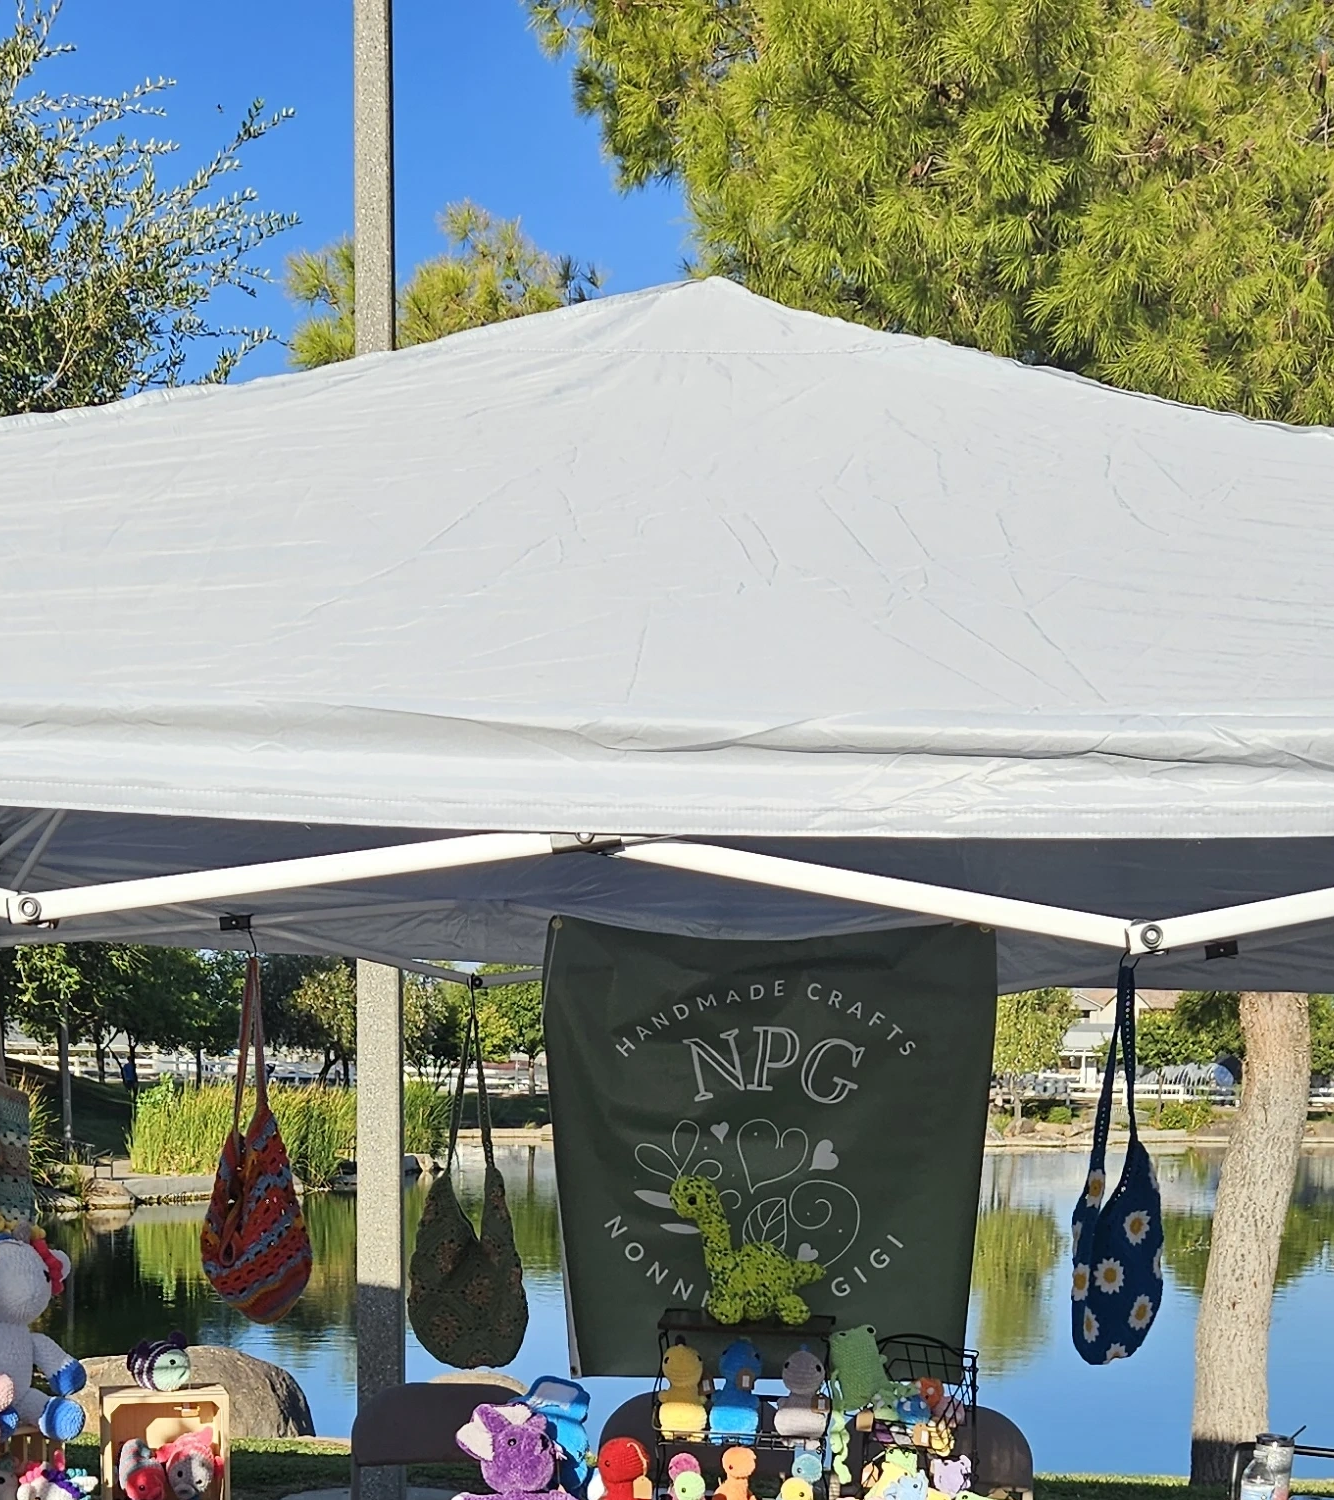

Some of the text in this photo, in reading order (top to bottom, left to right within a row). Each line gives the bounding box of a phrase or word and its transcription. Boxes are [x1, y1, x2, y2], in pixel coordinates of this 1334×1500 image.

[615, 979, 916, 1058] HANDMADE CRAFTS
[682, 1025, 866, 1104] NPG
[830, 1234, 904, 1297] GIGI
